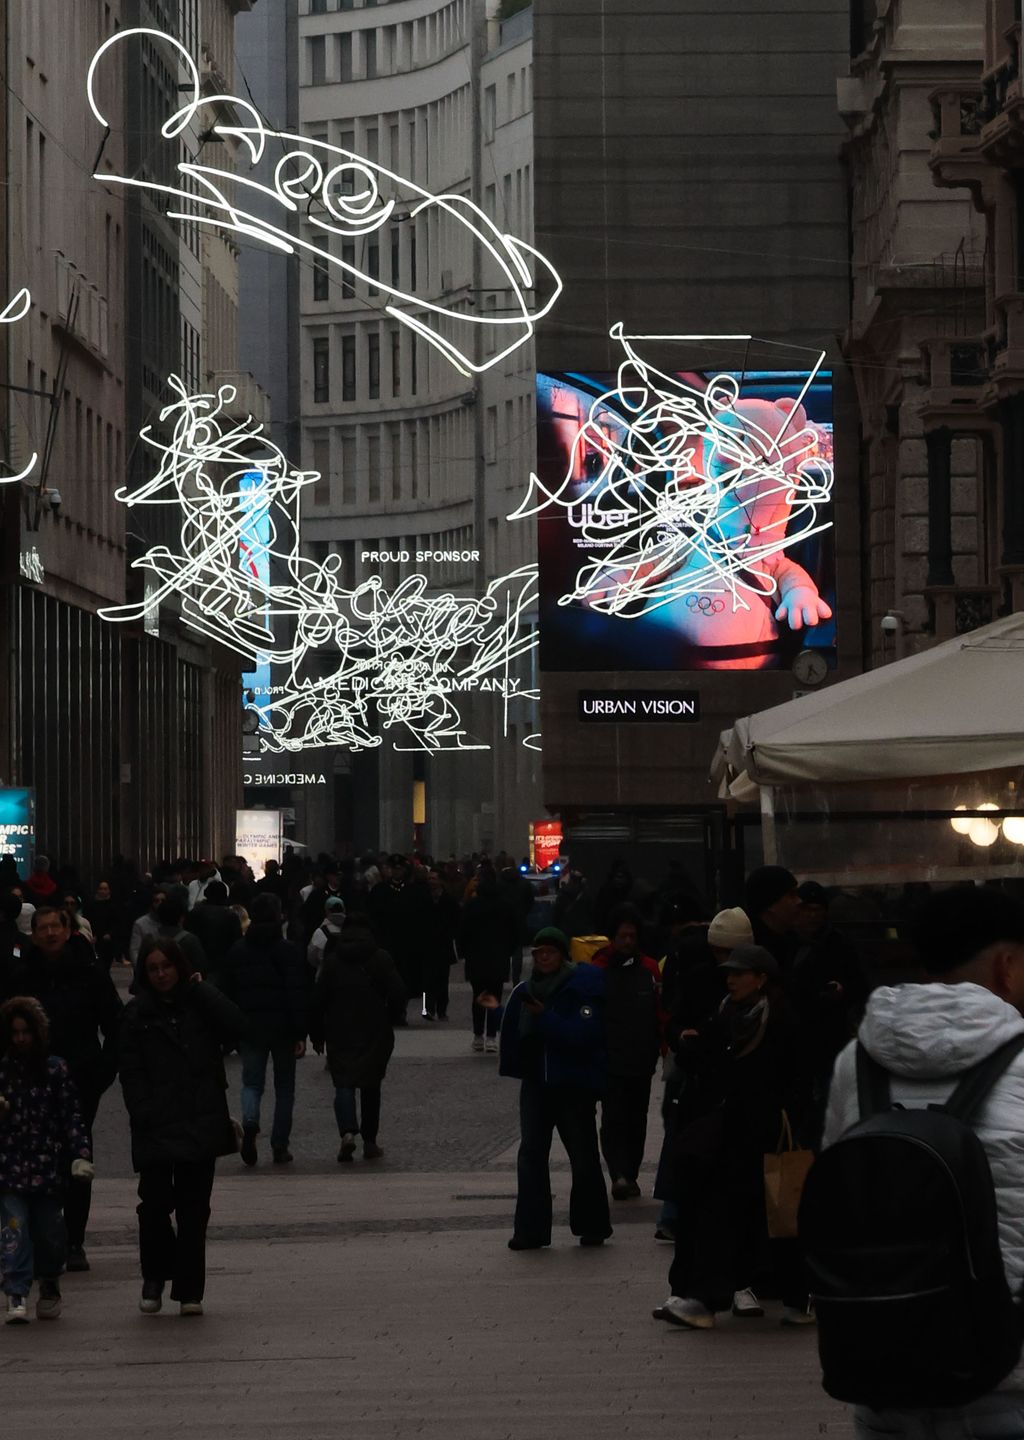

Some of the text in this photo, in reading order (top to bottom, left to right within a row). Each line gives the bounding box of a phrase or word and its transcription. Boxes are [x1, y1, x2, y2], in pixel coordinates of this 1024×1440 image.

[361, 550, 480, 562] PROUD SPONSOR
[583, 700, 695, 714] URBAN VISION
